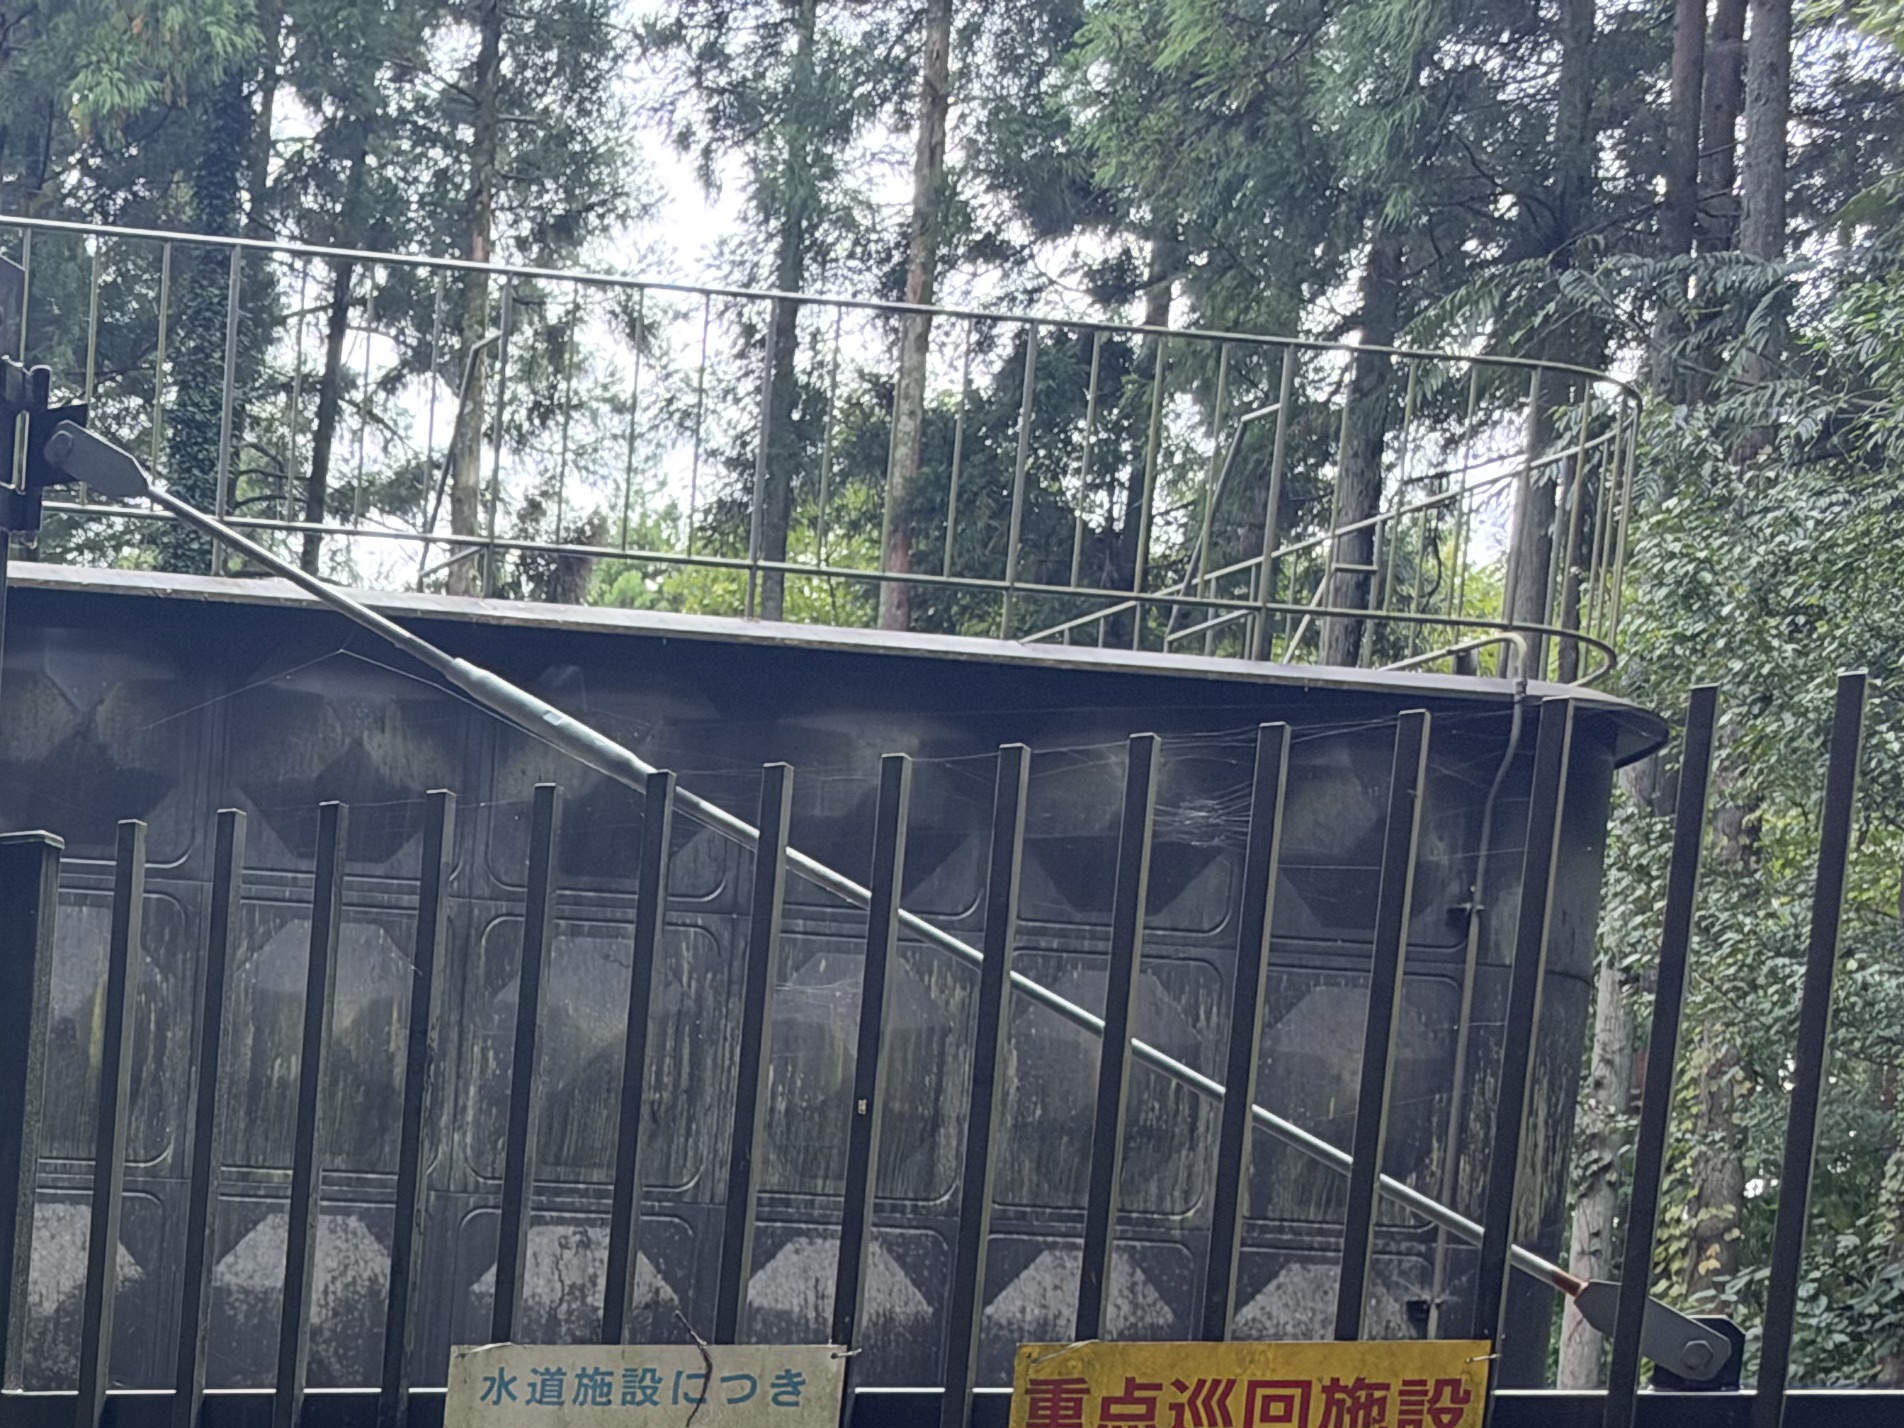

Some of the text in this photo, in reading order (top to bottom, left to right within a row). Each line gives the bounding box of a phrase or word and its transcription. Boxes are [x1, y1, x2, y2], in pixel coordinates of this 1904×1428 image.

[479, 1365, 807, 1408] 水道施設につき
